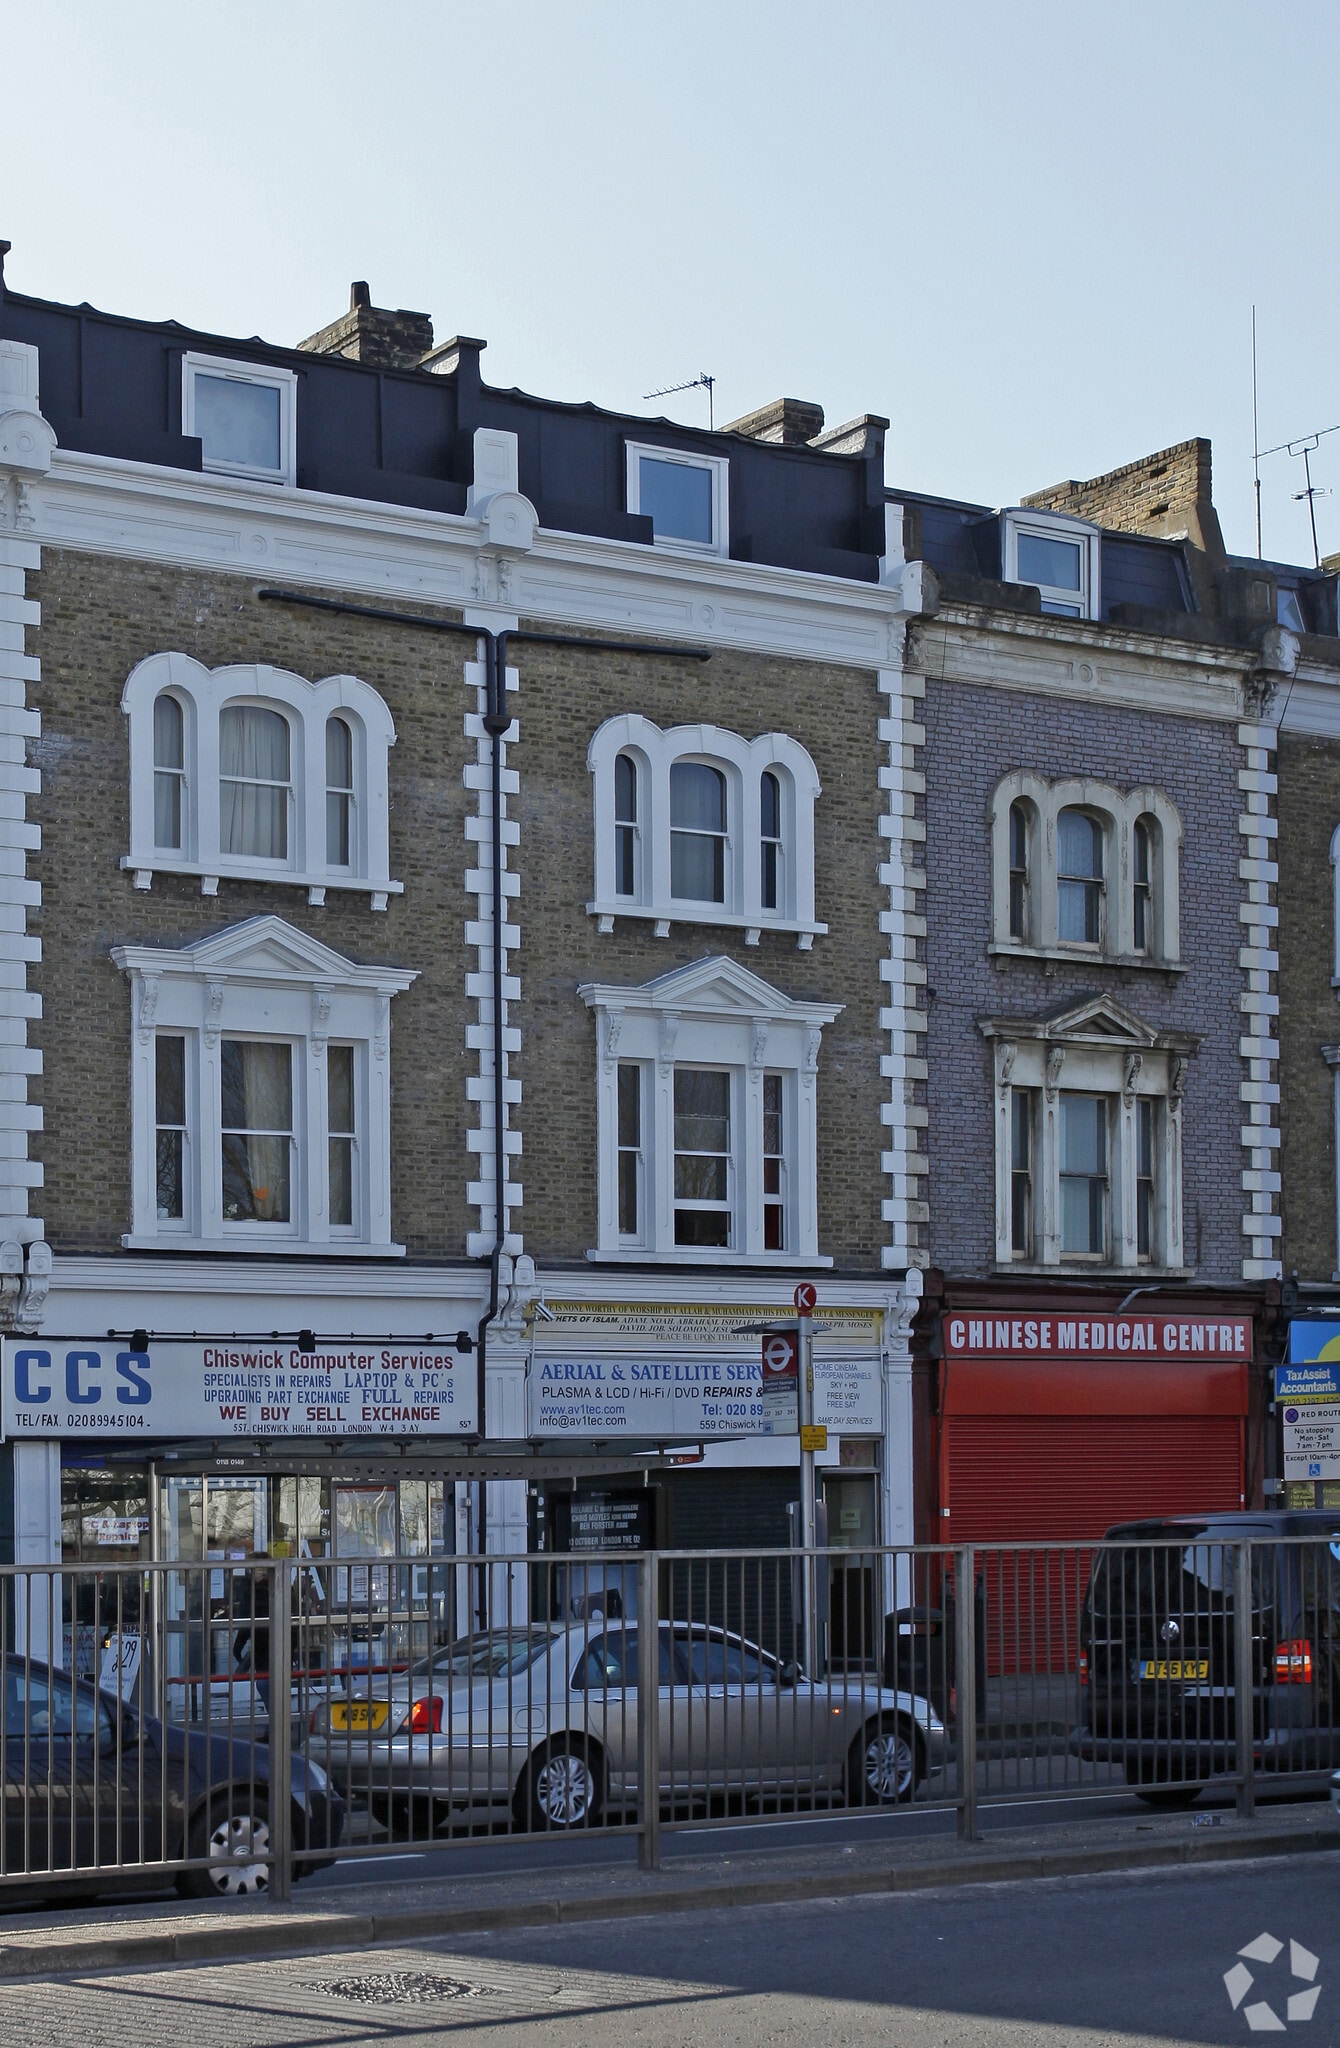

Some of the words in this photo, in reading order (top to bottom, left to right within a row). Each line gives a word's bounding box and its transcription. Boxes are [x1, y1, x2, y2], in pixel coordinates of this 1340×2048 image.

[798, 1286, 810, 1307] K
[563, 1304, 583, 1312] NONE
[585, 1305, 618, 1313] WORTHY
[630, 1306, 662, 1314] WORSHIP
[664, 1306, 678, 1314] BUT
[680, 1306, 702, 1315] ALLAH
[712, 1307, 754, 1316] MUHAMMAD
[763, 1308, 775, 1316] HIS
[776, 1308, 796, 1316] FINAL
[695, 1333, 716, 1341] UPON
[740, 1334, 754, 1342] ALL
[950, 1320, 1051, 1349] CHINESE
[1058, 1322, 1157, 1350] MEDICAL
[1163, 1324, 1245, 1352] CENTRE
[204, 1349, 284, 1369] Chiswick
[290, 1350, 374, 1374] Computer
[381, 1350, 453, 1370] Services
[540, 1364, 606, 1380] AERIAL
[611, 1364, 626, 1380] &
[631, 1365, 721, 1380] SATELLITE
[1286, 1368, 1331, 1381] TaxAssist
[204, 1374, 271, 1388] SPECIALISTS
[276, 1375, 285, 1388] IN
[290, 1375, 331, 1388] REPAIRS
[344, 1372, 398, 1388] LAPTOP
[405, 1373, 414, 1388] &
[542, 1387, 591, 1398] PLASMA
[595, 1387, 602, 1398] &
[606, 1387, 630, 1398] LCD
[640, 1387, 664, 1398] Hi-Fi
[675, 1388, 699, 1398] DVD
[703, 1387, 752, 1398] REPAIRS
[756, 1387, 762, 1398] &
[1280, 1381, 1337, 1394] Accountants
[204, 1390, 261, 1404] UPGRADING
[268, 1391, 292, 1404] PART
[298, 1391, 350, 1404] EXCHANGE
[362, 1389, 402, 1404] FULL
[414, 1391, 454, 1404] REPAIRS
[219, 1406, 246, 1420] WE
[261, 1407, 290, 1421] BUY
[307, 1407, 346, 1421] SELL
[362, 1407, 440, 1421] EXCHANGE
[540, 1404, 625, 1414] www.av1tec.com
[702, 1404, 722, 1416] Tel:
[726, 1404, 746, 1416] 020
[540, 1414, 627, 1428] info@av1tec.com
[700, 1420, 716, 1429] 559
[718, 1420, 755, 1429] Chiswick
[253, 1424, 288, 1433] CHISWICK
[292, 1424, 311, 1433] HIGH
[317, 1424, 336, 1433] ROAD
[343, 1424, 372, 1433] LONDON
[379, 1424, 394, 1432] W4
[1306, 1427, 1334, 1435] stopping
[580, 1522, 590, 1530] BEN
[591, 1521, 614, 1529] FORSTER
[575, 1537, 599, 1546] OCTOBER
[602, 1536, 621, 1544] LONDON
